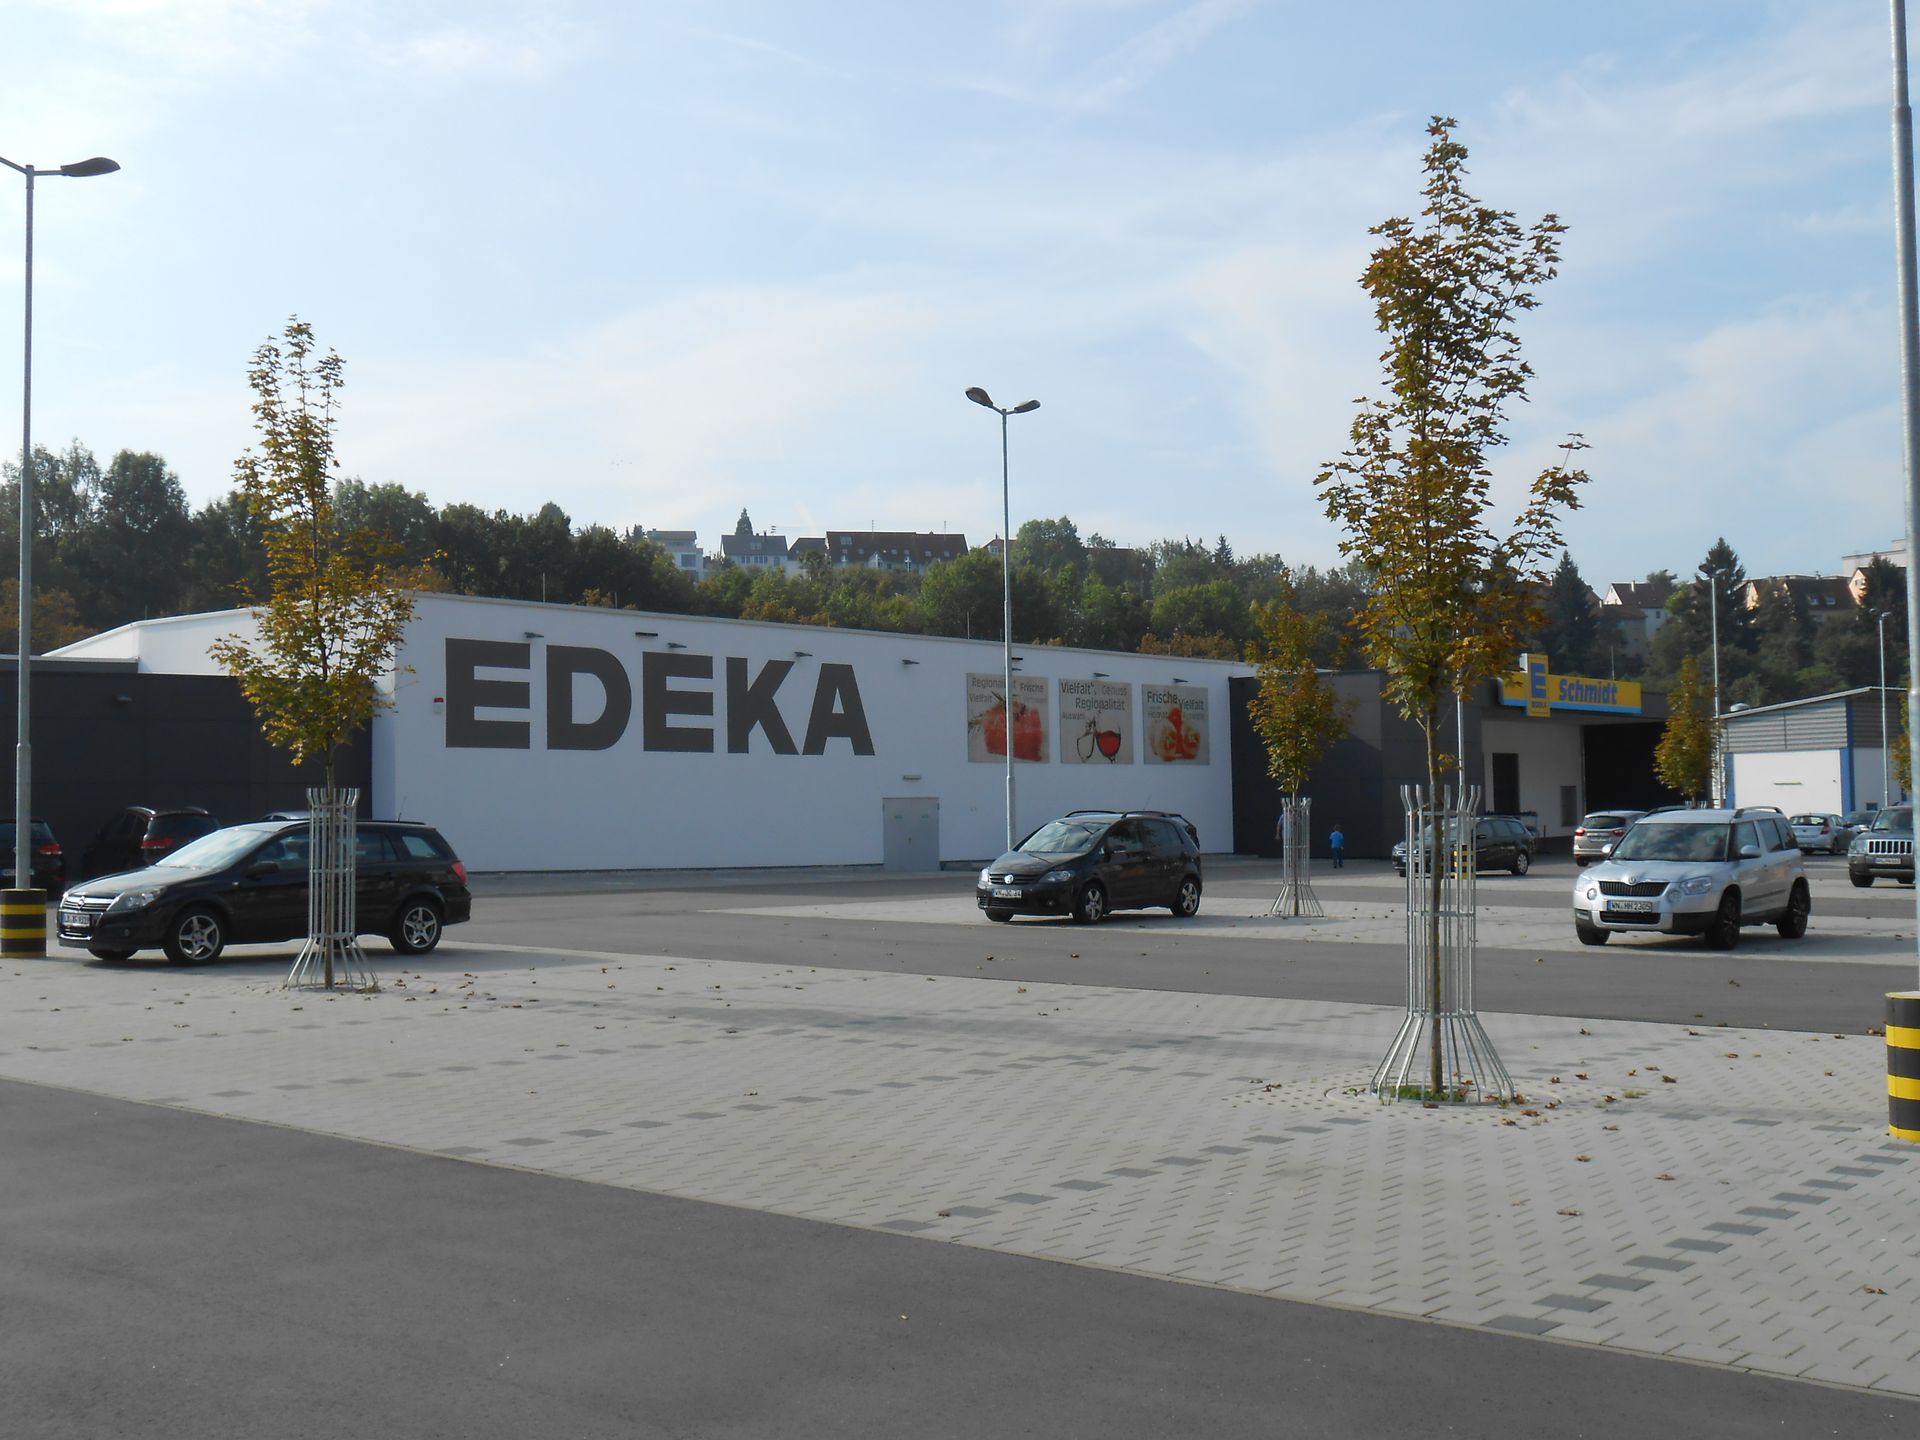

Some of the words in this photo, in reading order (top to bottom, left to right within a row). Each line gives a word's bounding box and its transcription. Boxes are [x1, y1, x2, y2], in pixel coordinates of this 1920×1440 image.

[1530, 662, 1547, 699] E
[1559, 678, 1618, 704] Schmidt
[445, 638, 876, 756] EDEKA
[1147, 690, 1178, 705] Frische
